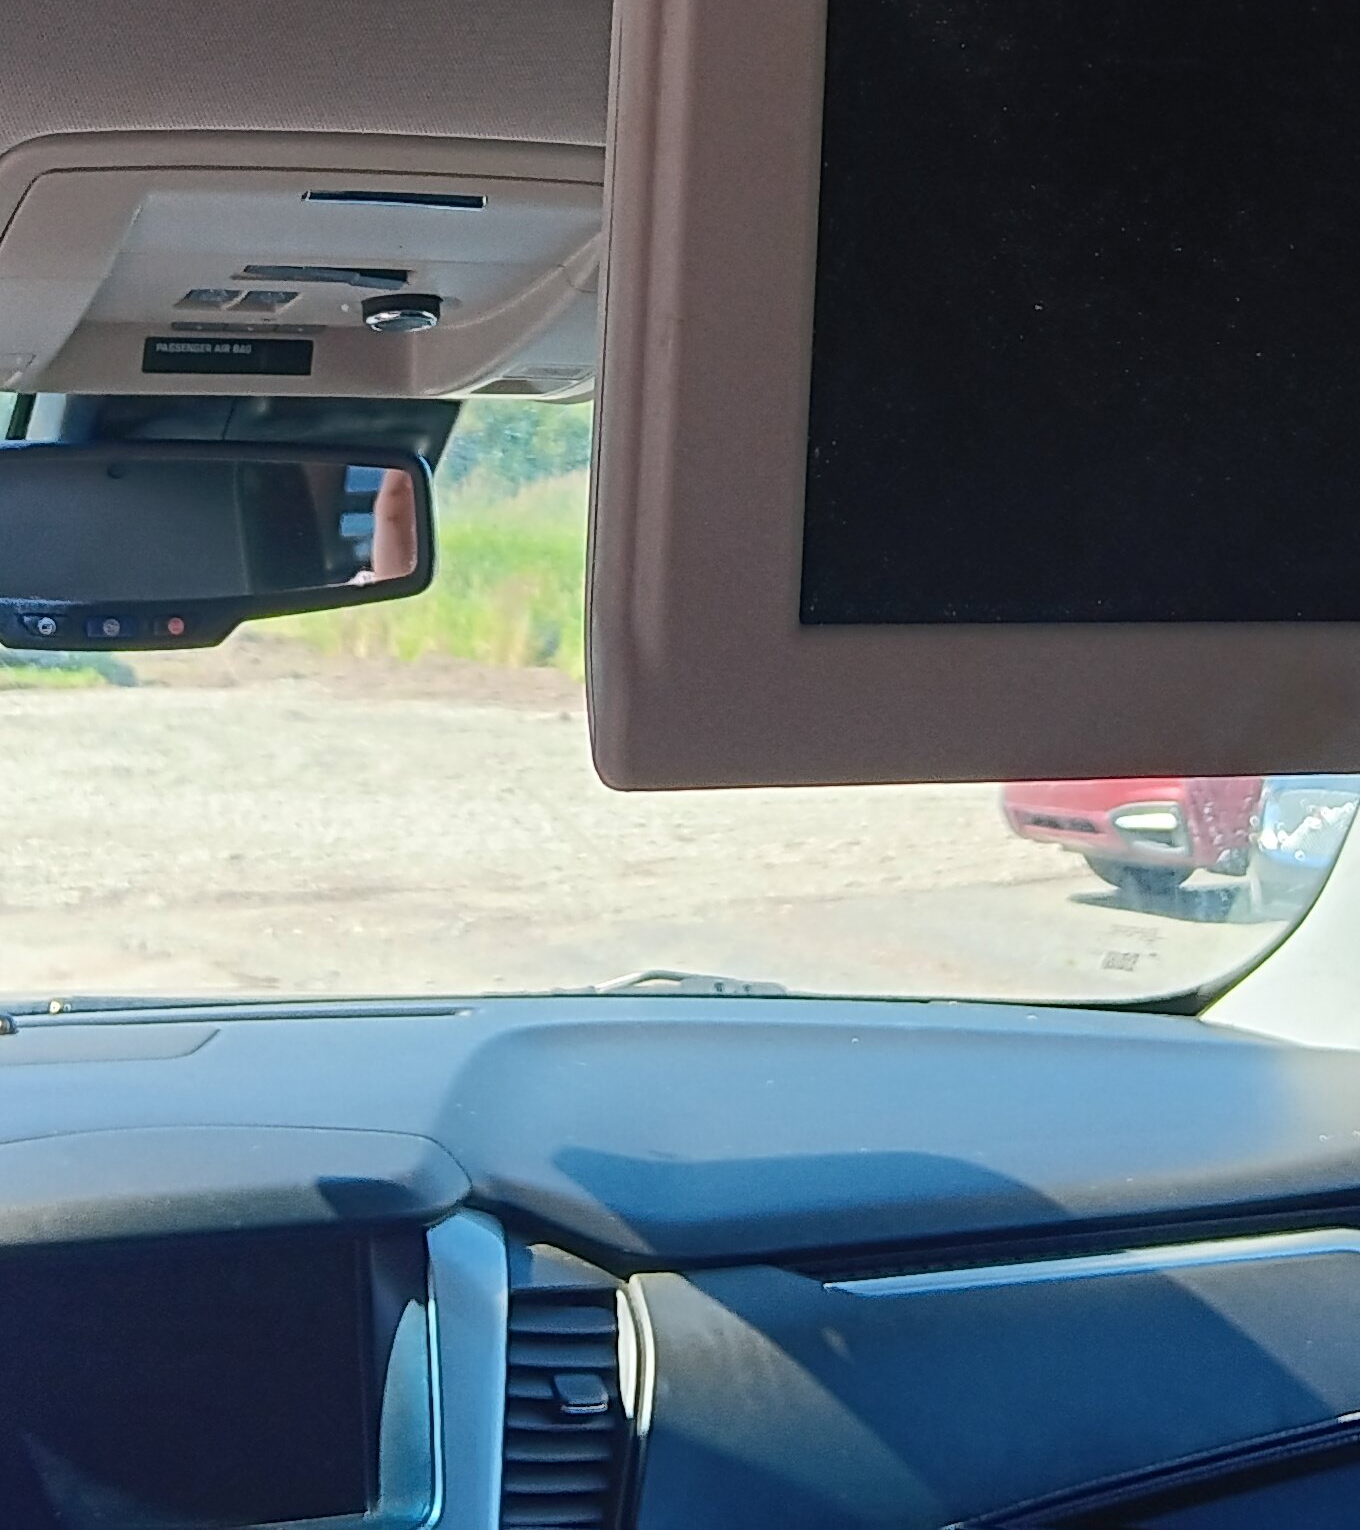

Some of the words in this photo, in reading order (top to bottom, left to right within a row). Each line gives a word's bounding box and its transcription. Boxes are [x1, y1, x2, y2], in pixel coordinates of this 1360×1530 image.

[156, 343, 212, 353] PASSENGER
[214, 343, 231, 353] AIR
[232, 344, 252, 354] BAG
